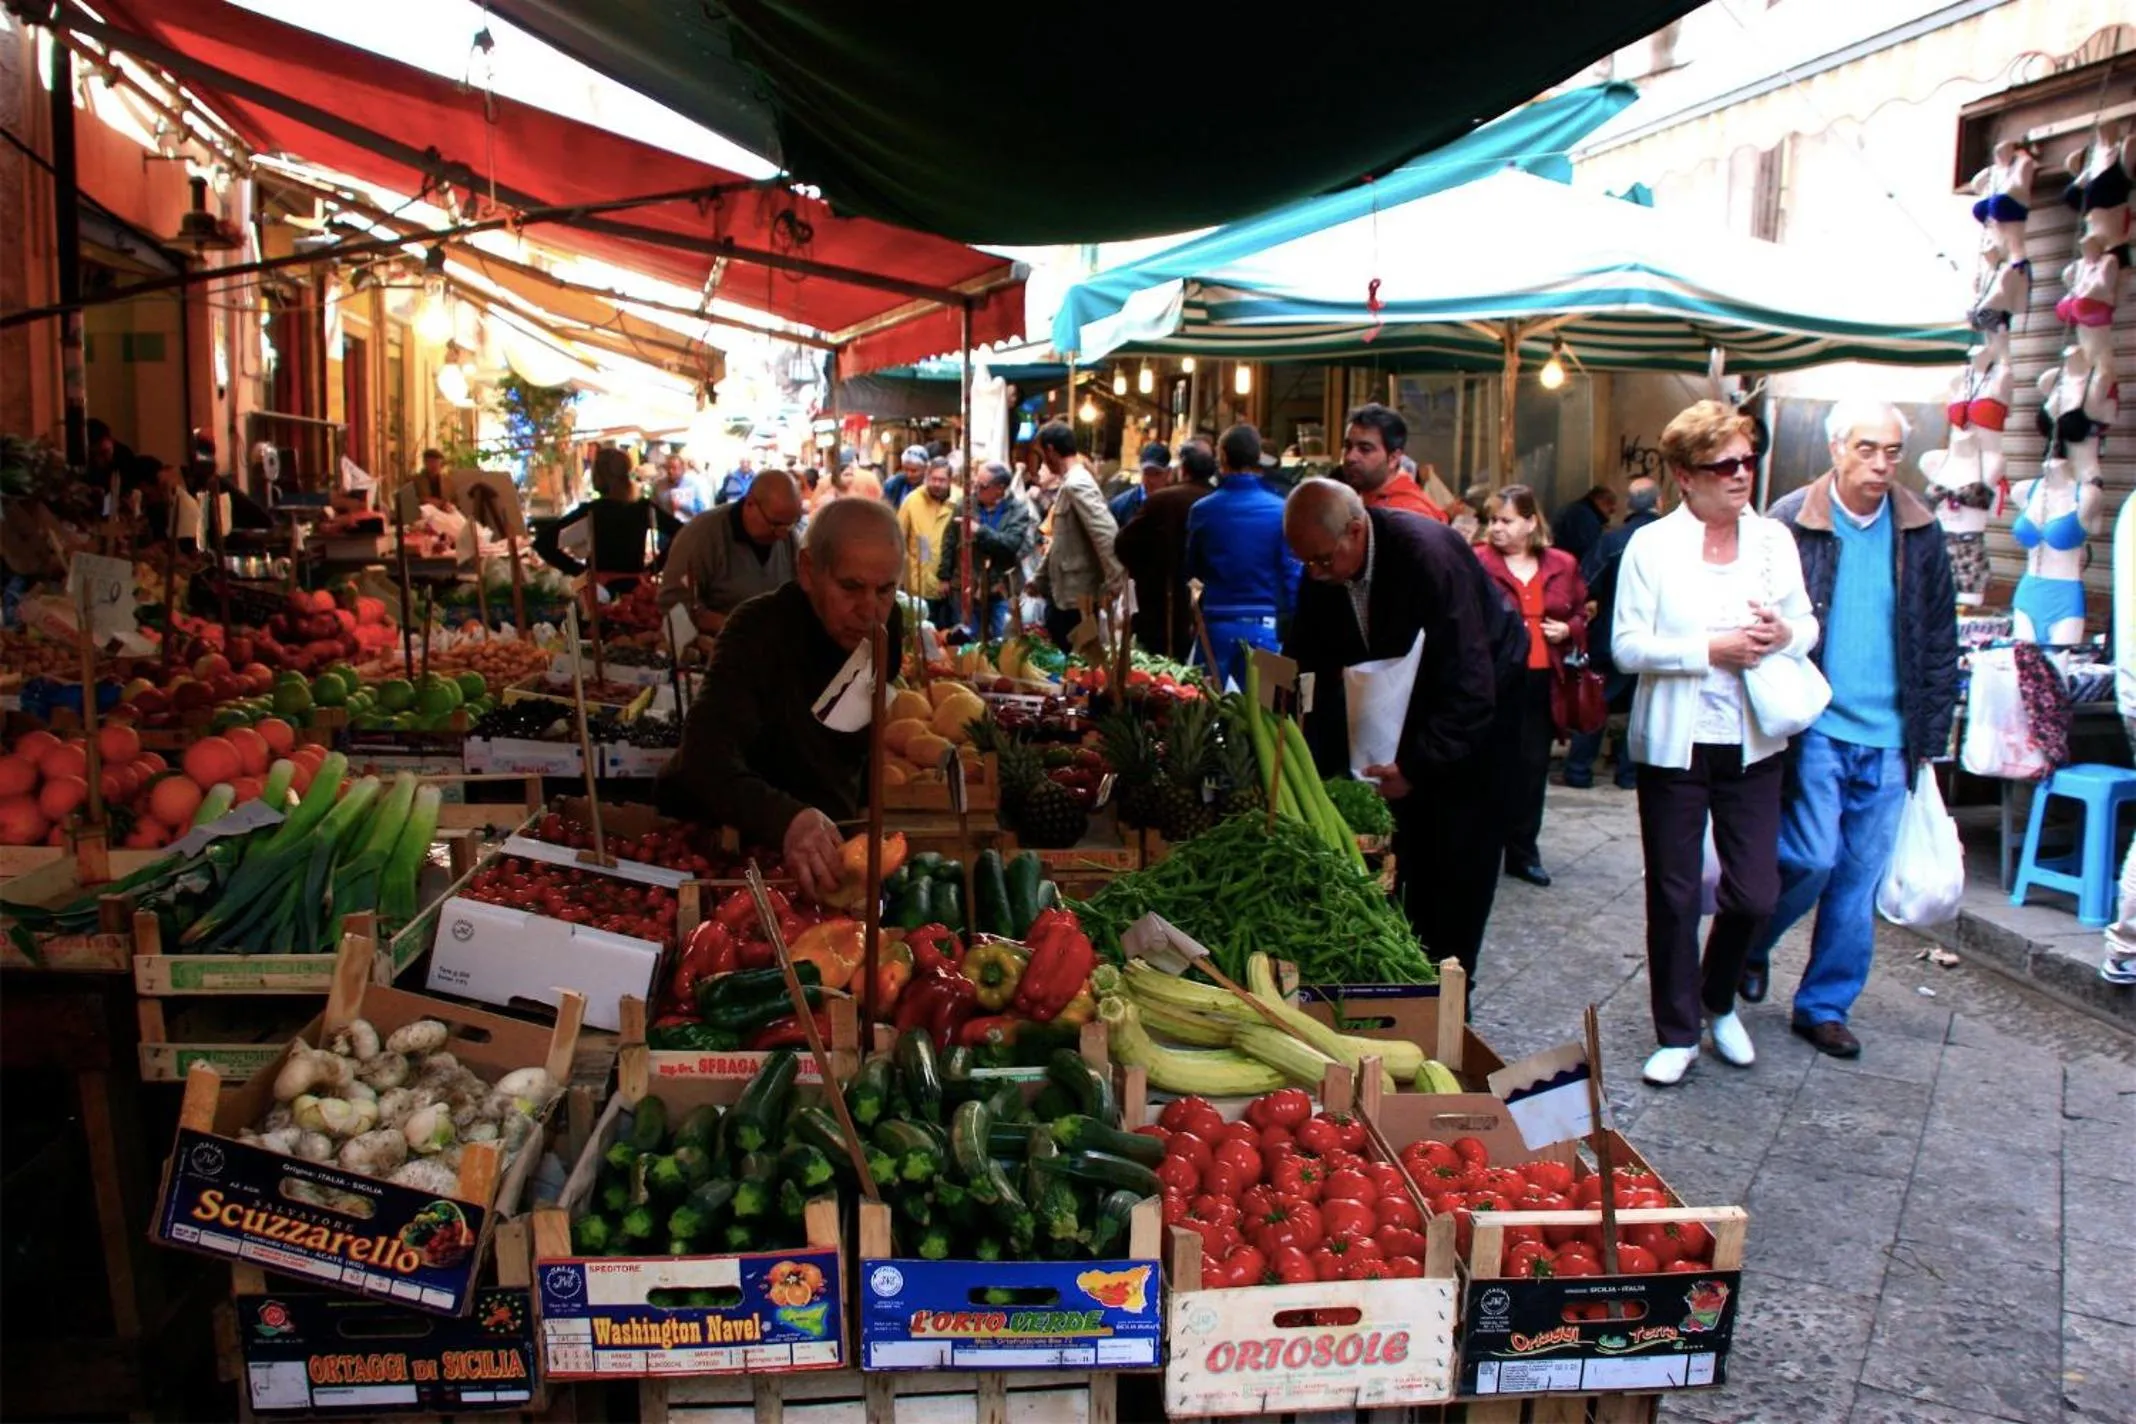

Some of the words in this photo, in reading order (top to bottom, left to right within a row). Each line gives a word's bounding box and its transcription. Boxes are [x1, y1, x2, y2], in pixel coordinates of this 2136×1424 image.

[317, 1172, 346, 1187] ITALIA
[352, 1182, 384, 1197] SICILIA
[252, 1198, 355, 1233] SALVATORE
[191, 1188, 421, 1274] Scuzzarello
[589, 1264, 643, 1274] SPEDITORE
[1590, 1286, 1617, 1294] SICILIA
[1621, 1284, 1646, 1293] ITALIA
[592, 1315, 702, 1349] Washington
[706, 1312, 761, 1344] Navel
[910, 1310, 1007, 1334] L'ORTO
[1010, 1309, 1105, 1334] VERDE
[1629, 1326, 1678, 1344] Terra
[308, 1352, 409, 1383] ORTAGGI
[412, 1359, 439, 1381] DI
[441, 1348, 527, 1381] SICILIA
[1205, 1330, 1410, 1374] ORTOSOLE
